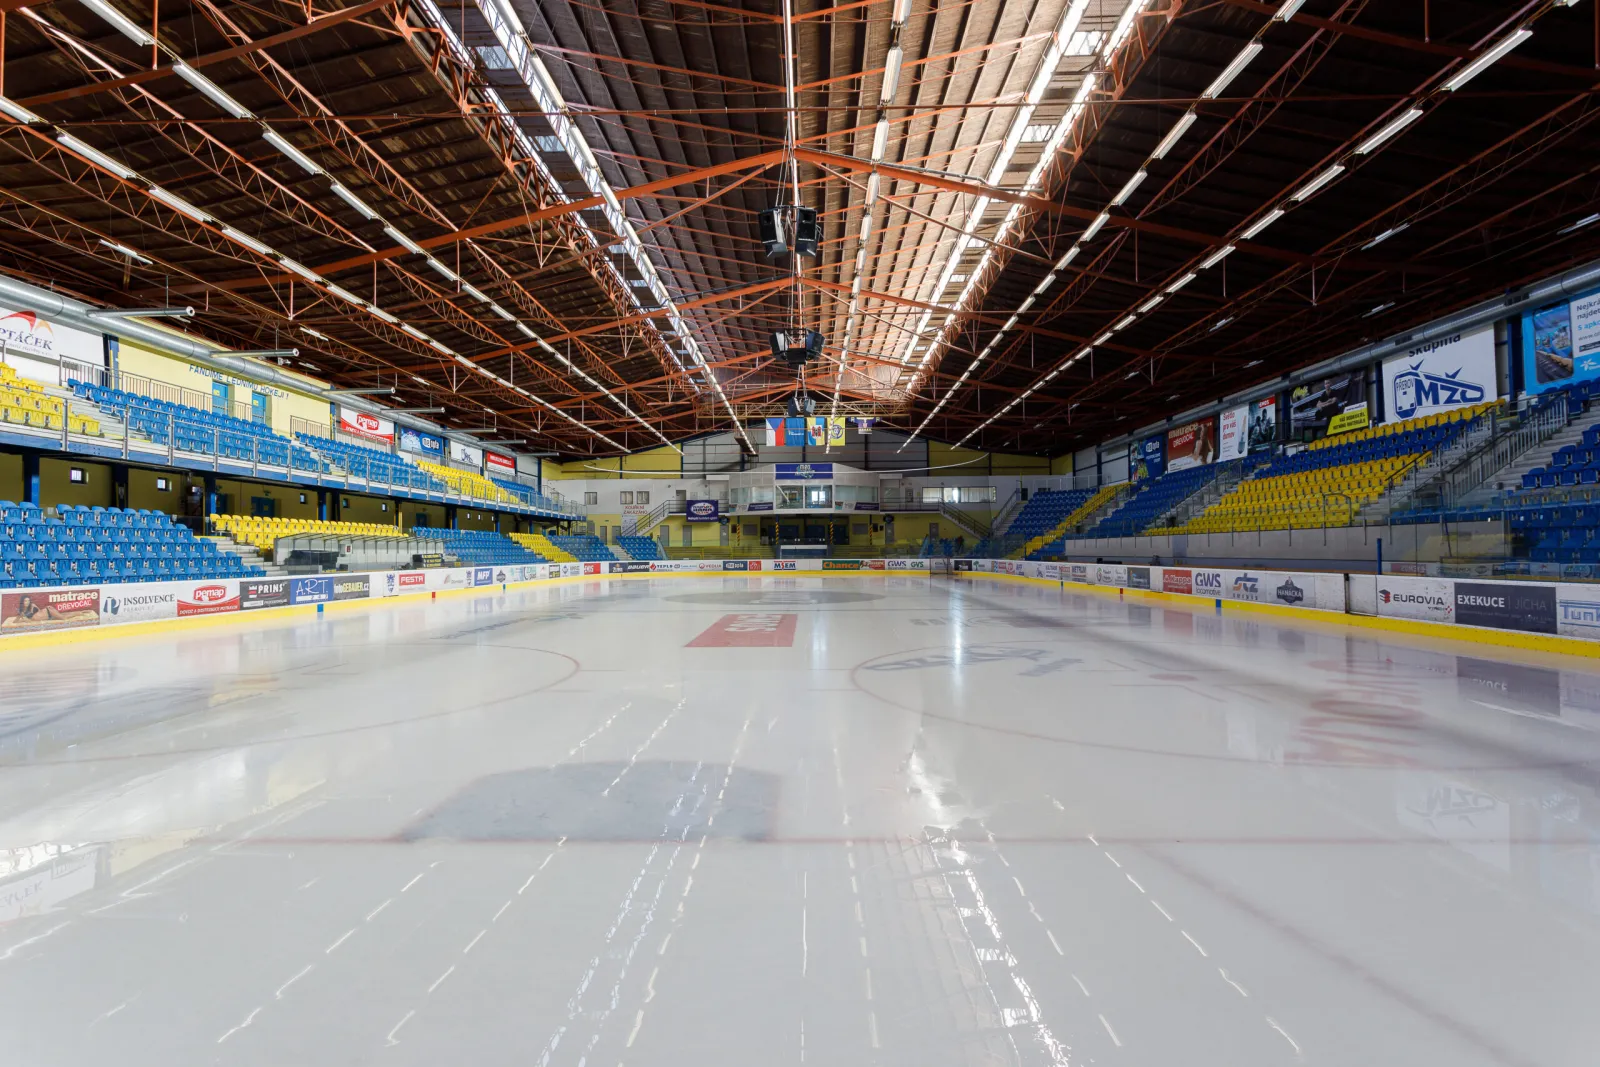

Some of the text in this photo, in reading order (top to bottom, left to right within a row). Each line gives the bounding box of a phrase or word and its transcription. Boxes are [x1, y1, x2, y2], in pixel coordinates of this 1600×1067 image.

[823, 561, 859, 569] Chance
[400, 575, 424, 584] FESTA
[1194, 572, 1222, 588] GWS
[258, 584, 283, 594] PRINS
[48, 591, 98, 603] matrace
[123, 593, 175, 606] INSOLVENCE
[1393, 593, 1445, 606] EUROVIA
[1457, 594, 1506, 608] EXEKUCE
